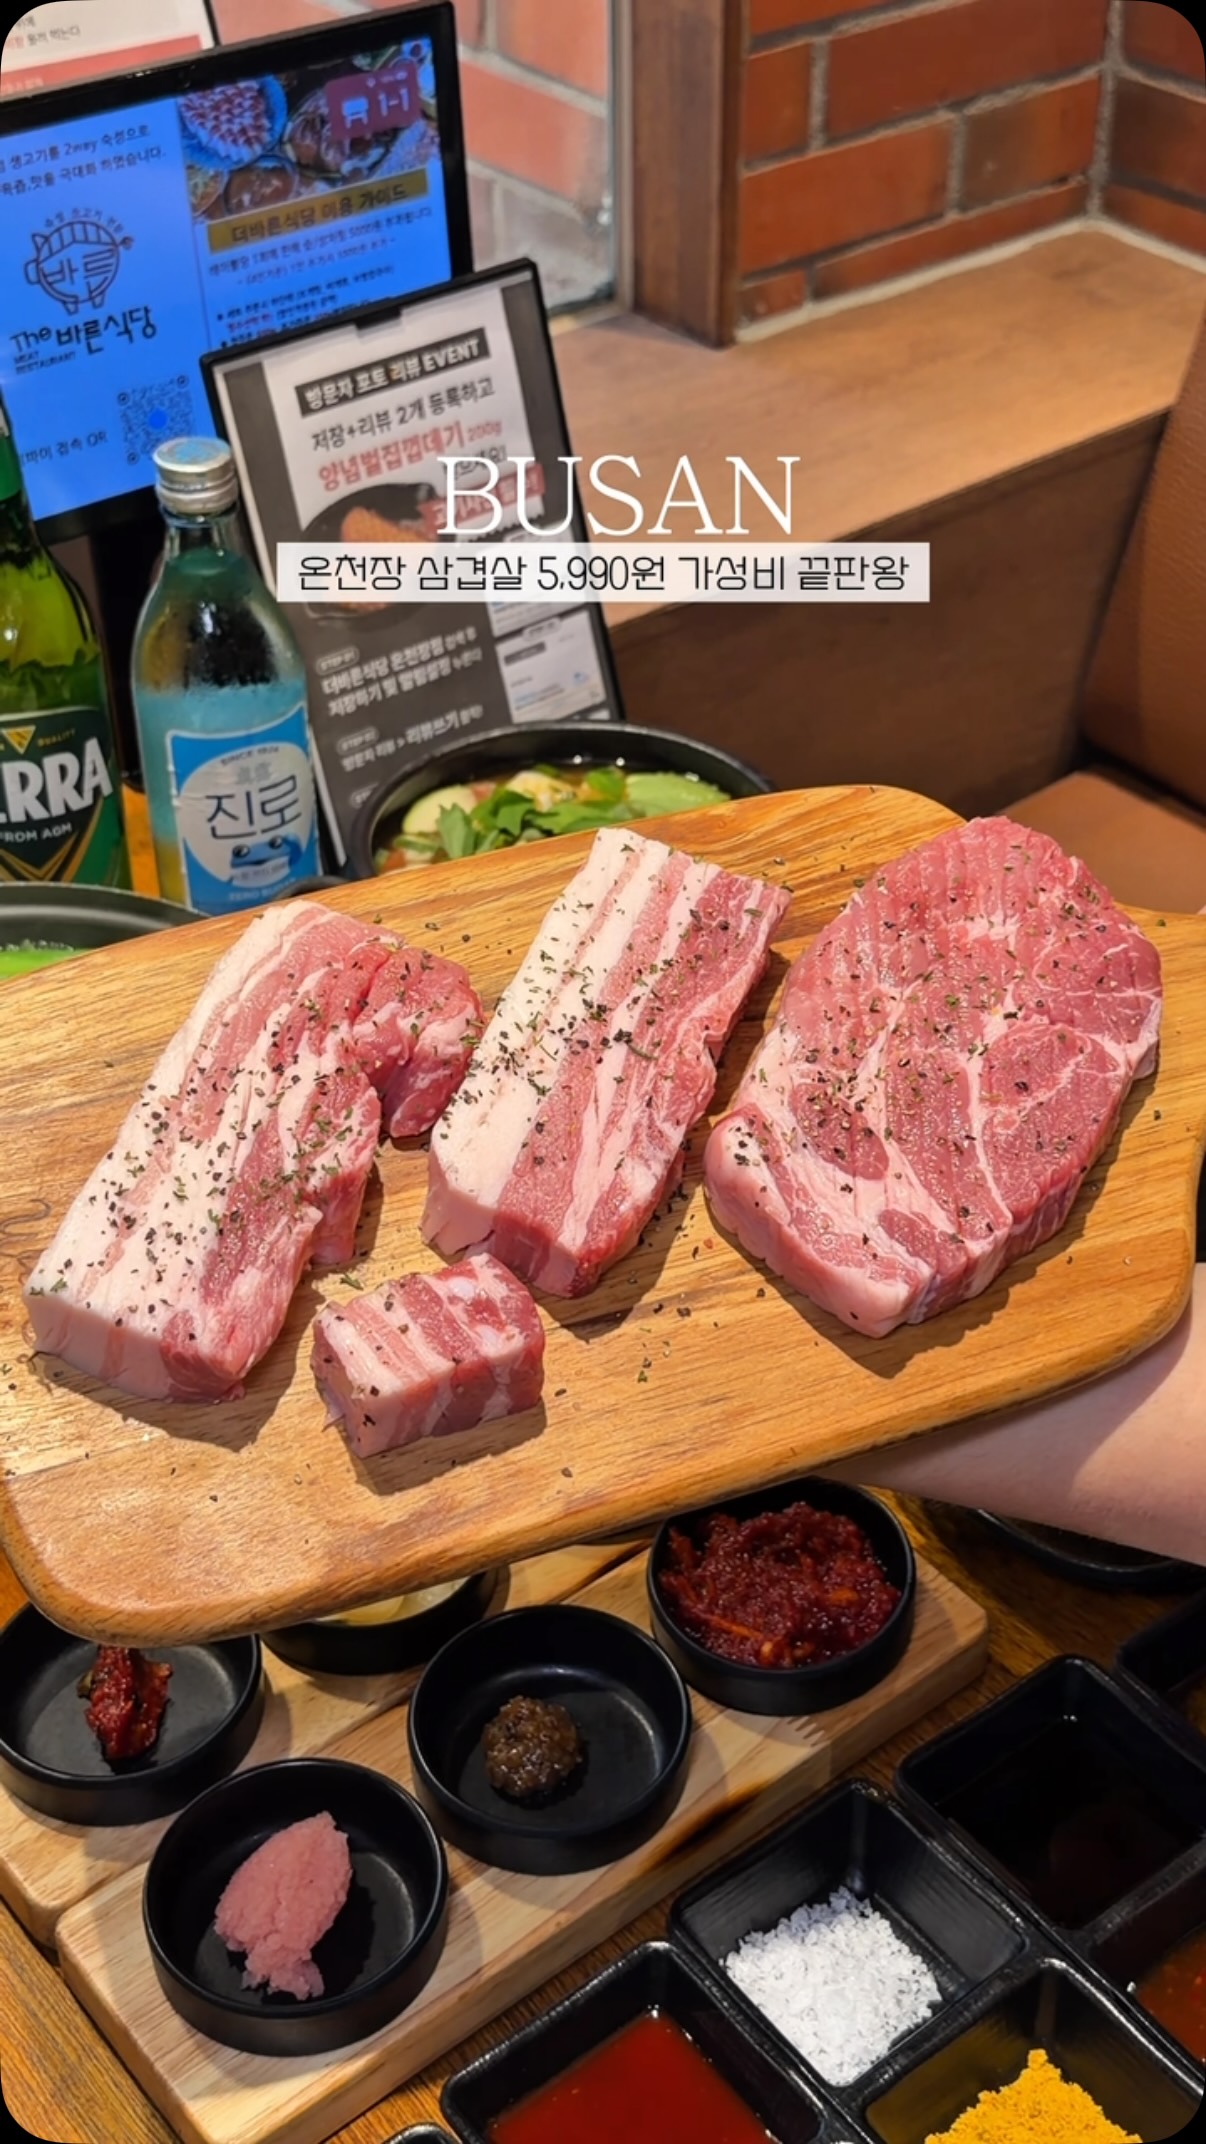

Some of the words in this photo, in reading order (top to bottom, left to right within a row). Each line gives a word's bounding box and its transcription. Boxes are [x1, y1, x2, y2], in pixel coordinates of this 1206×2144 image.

[101, 125, 150, 147] 숙성으로
[231, 202, 316, 244] 더바른식당
[321, 195, 353, 222] 이용
[359, 183, 409, 211] 가이드
[10, 326, 52, 352] The
[56, 305, 157, 355] 바른식당
[305, 378, 354, 410] 방문자
[356, 367, 389, 394] 포토
[389, 356, 422, 382] 리뷰
[422, 338, 480, 373] EVENT
[312, 410, 391, 451] 저장+리뷰
[396, 398, 426, 425] 2개
[429, 377, 496, 416] 등록하고
[318, 421, 465, 492] 양념벌집껍데기
[321, 656, 390, 694] 더바른식당
[390, 636, 444, 672] 온천장점
[37, 728, 76, 747] QUALITY
[0, 736, 114, 823] RRA
[206, 774, 302, 840] 진로
